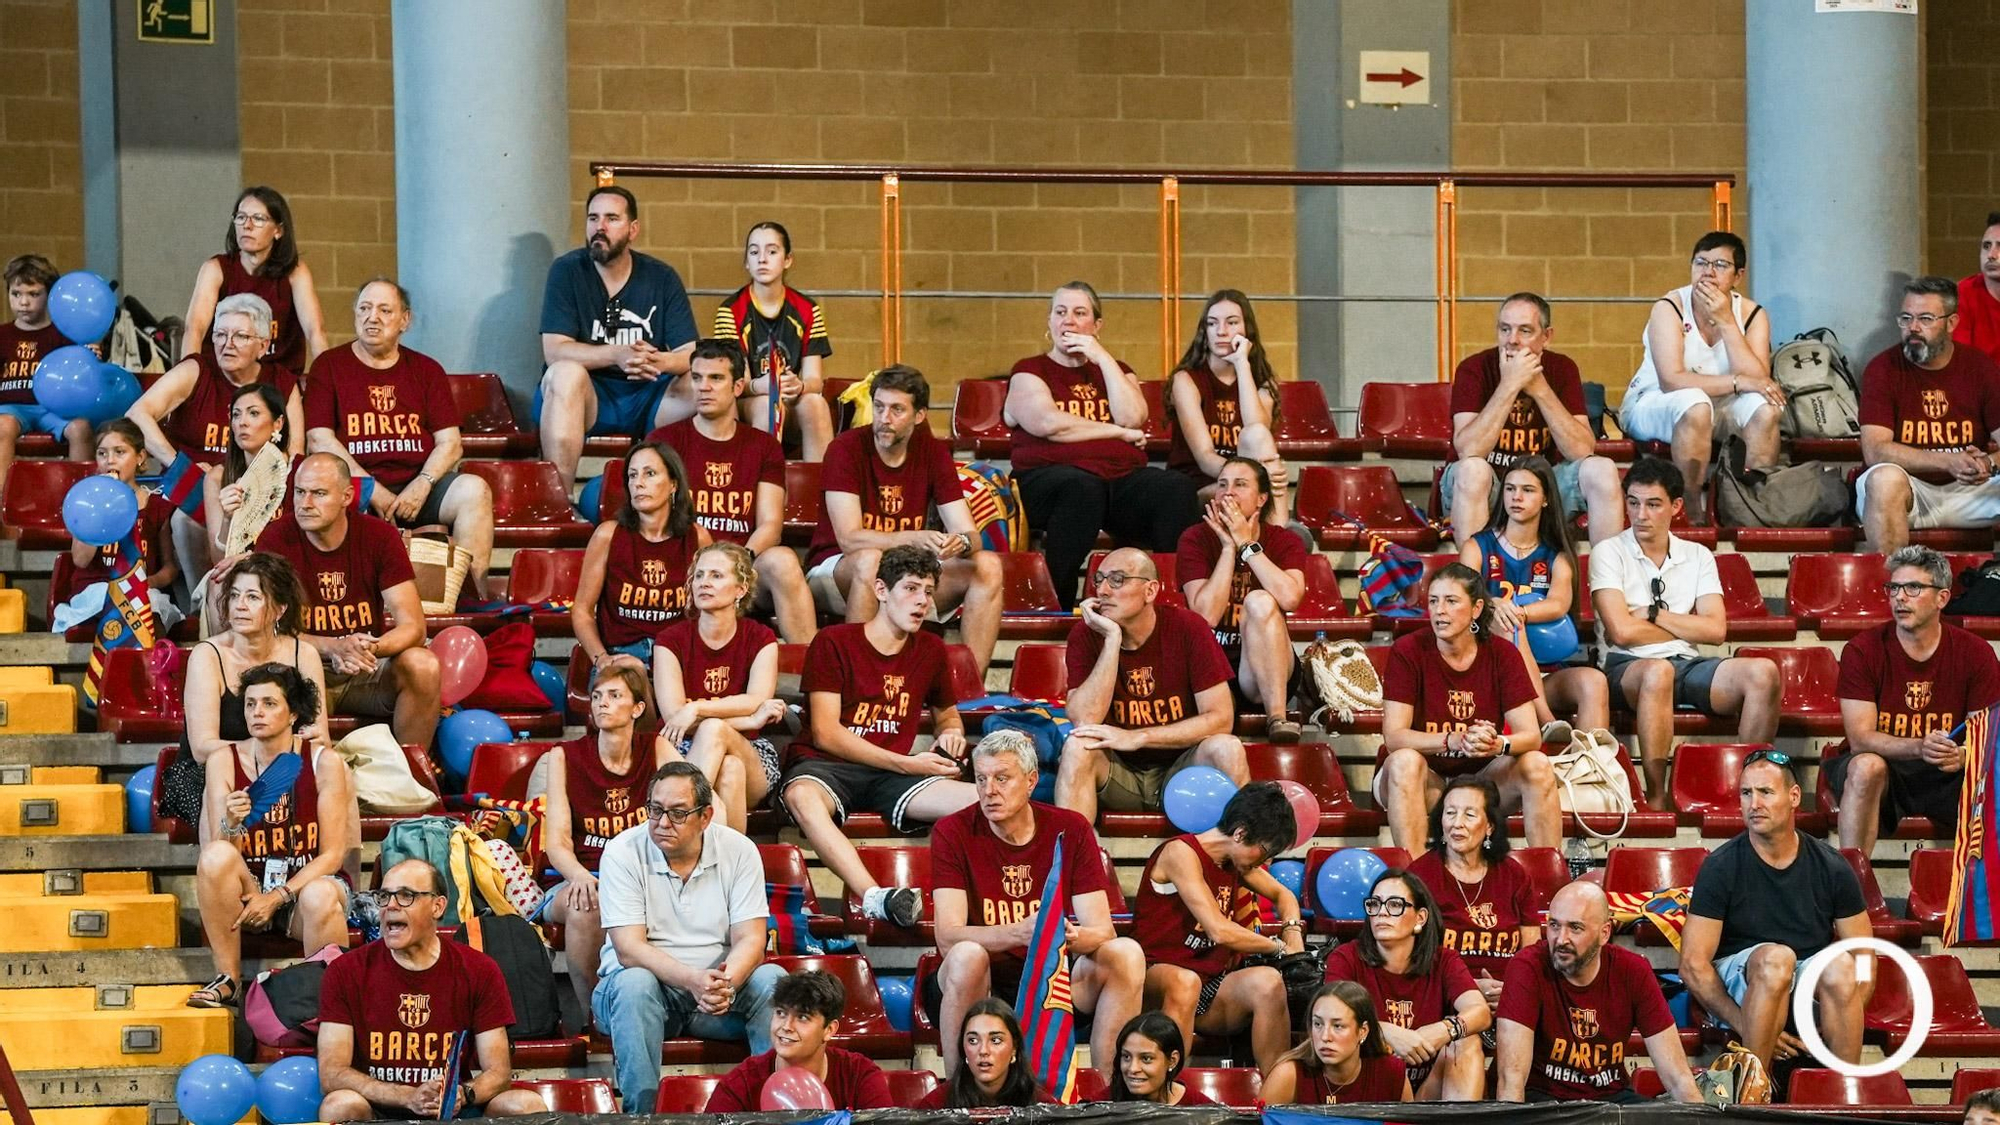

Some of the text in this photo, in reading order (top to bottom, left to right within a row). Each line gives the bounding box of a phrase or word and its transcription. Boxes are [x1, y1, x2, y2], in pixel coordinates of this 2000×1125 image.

[347, 412, 422, 440] BARÇA
[349, 439, 424, 455] BASKETBALL
[688, 491, 753, 520] ARÇA
[619, 582, 686, 611] BARÇA
[118, 600, 142, 631] FCB
[7, 961, 86, 976] ILA 4
[41, 1081, 102, 1094] FILA
